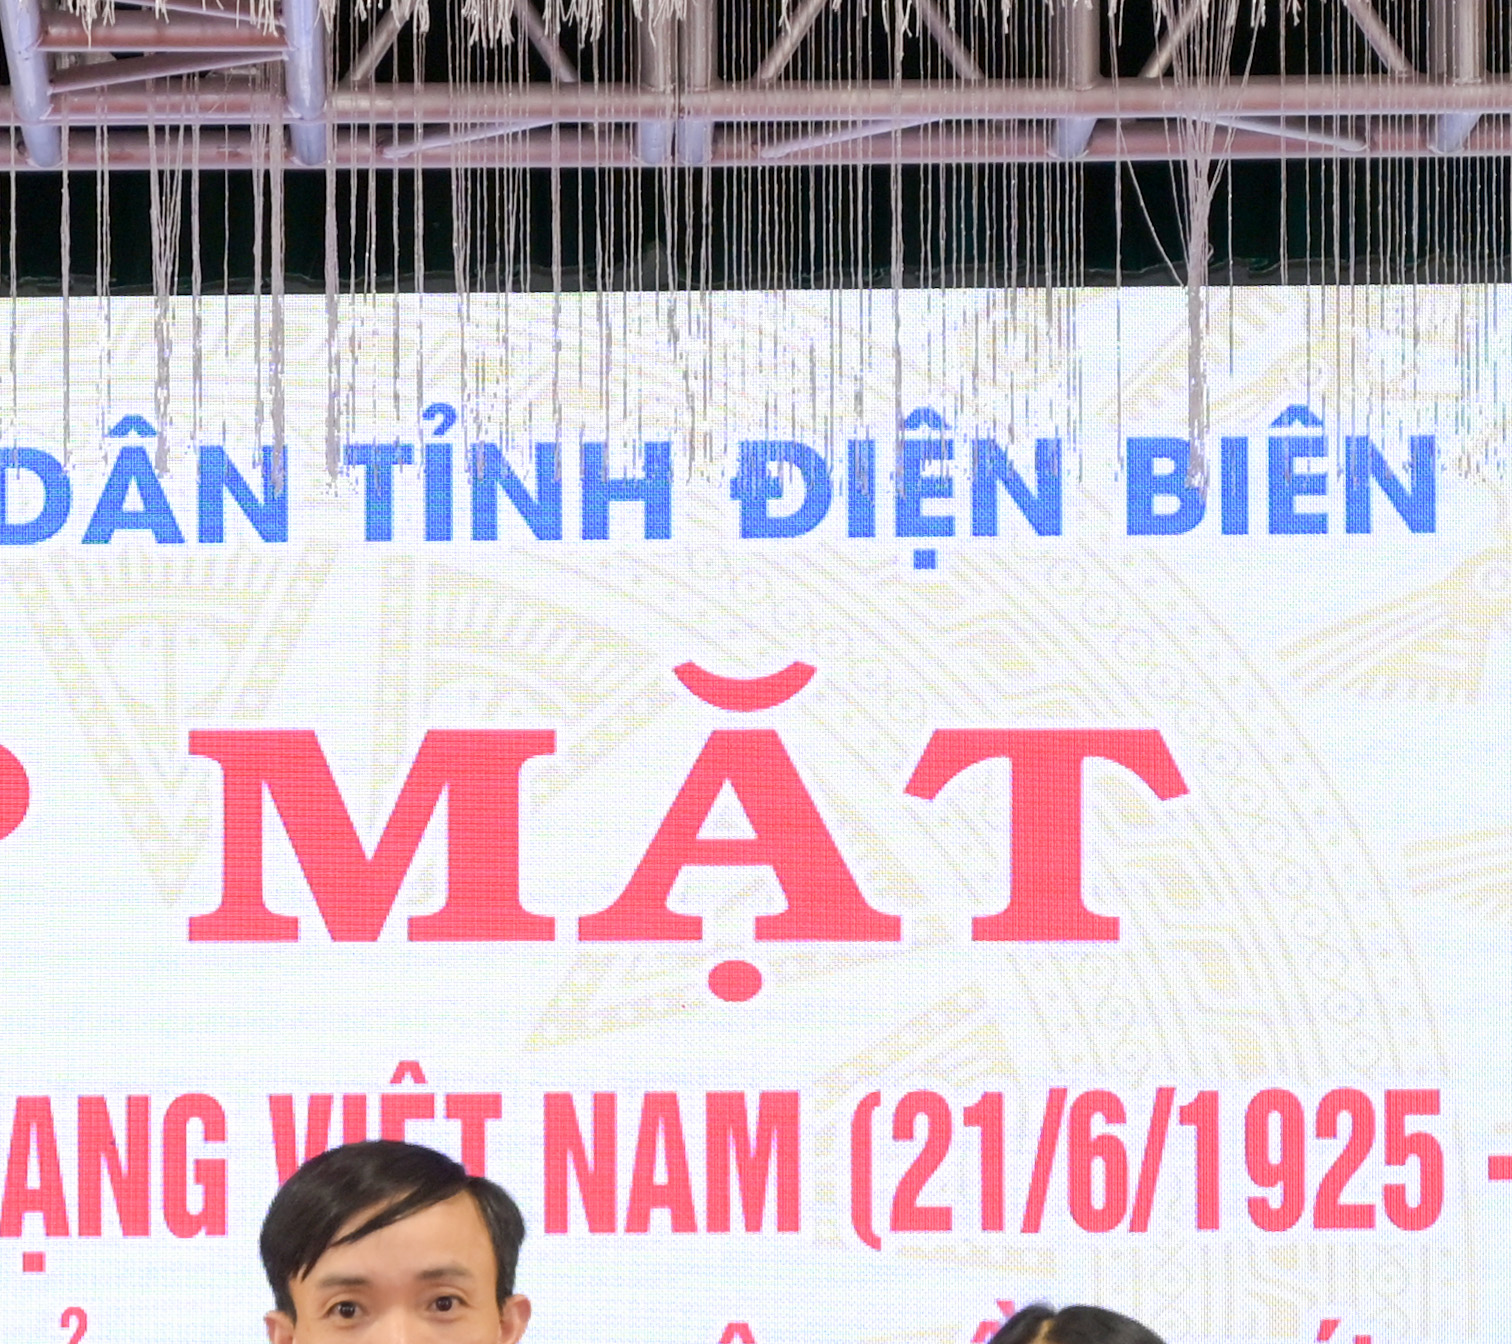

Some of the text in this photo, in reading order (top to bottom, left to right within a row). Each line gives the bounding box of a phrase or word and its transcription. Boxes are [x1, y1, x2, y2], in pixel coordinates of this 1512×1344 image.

[342, 401, 674, 542] TỈNH
[729, 406, 1064, 570] ĐIỆN
[1125, 402, 1439, 537] BIÊN
[186, 660, 1190, 1003] MẶT
[543, 1090, 800, 1234] NAM
[850, 1086, 1446, 1250] (21/6/1925
